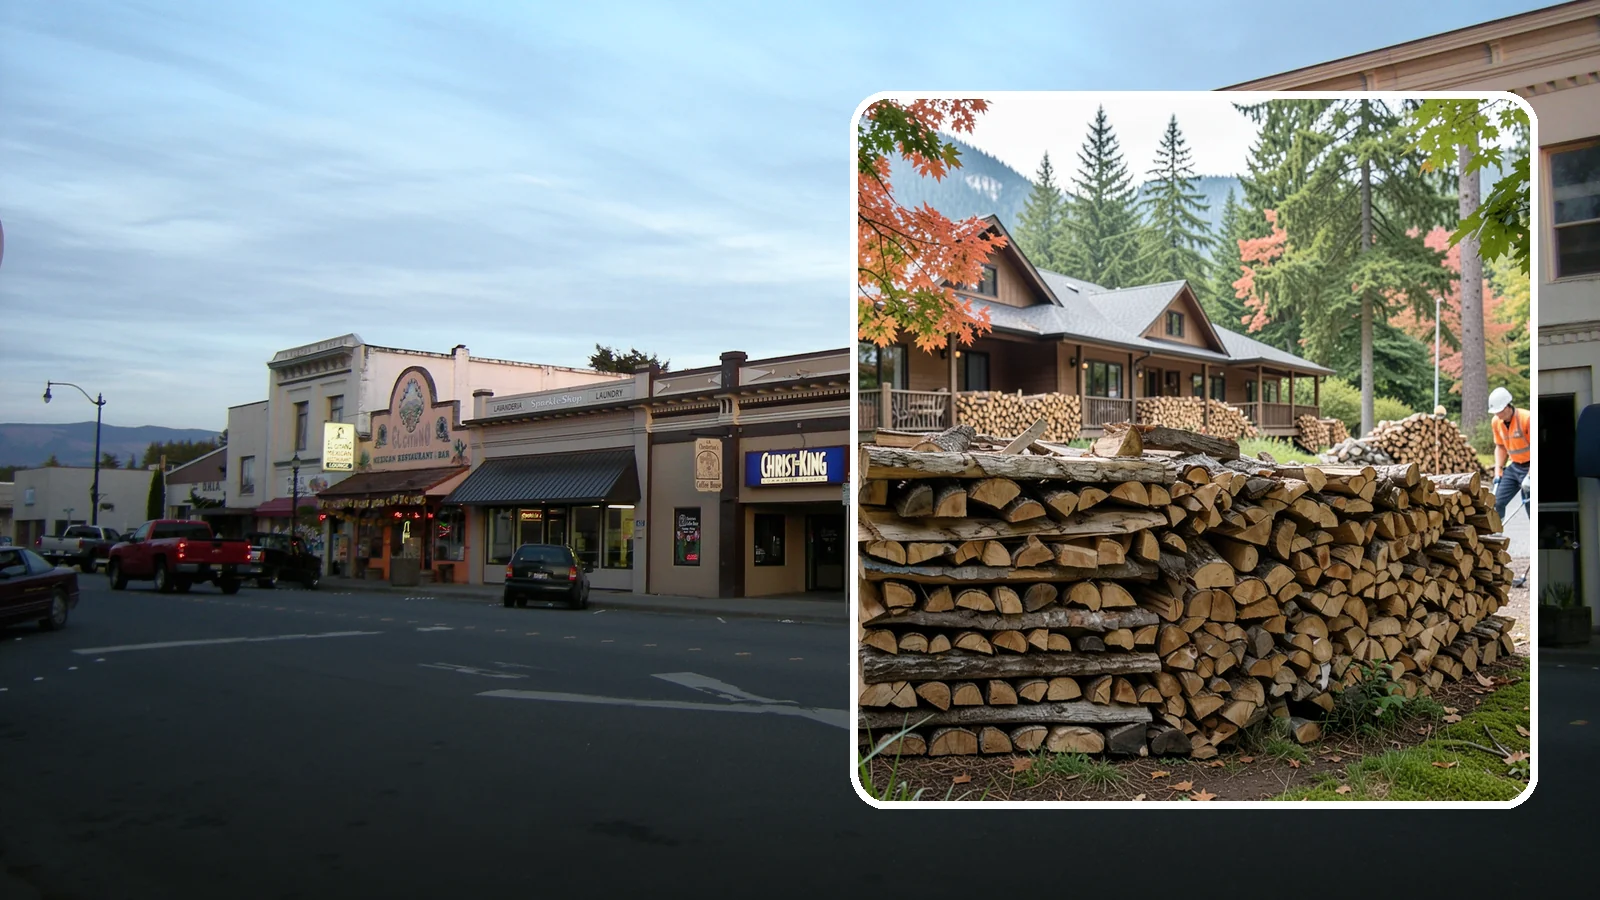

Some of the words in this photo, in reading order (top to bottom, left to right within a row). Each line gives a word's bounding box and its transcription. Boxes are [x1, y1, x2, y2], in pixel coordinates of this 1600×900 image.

[493, 402, 522, 412] LAVANDERIA
[561, 394, 582, 407] Shop
[595, 389, 624, 400] LAUNDRY
[391, 425, 402, 449] EL
[373, 454, 396, 464] MEXICAN
[397, 451, 433, 462] RESTAURANT
[438, 450, 450, 459] BAR
[760, 452, 797, 478] CHRIST
[799, 450, 827, 476] KING
